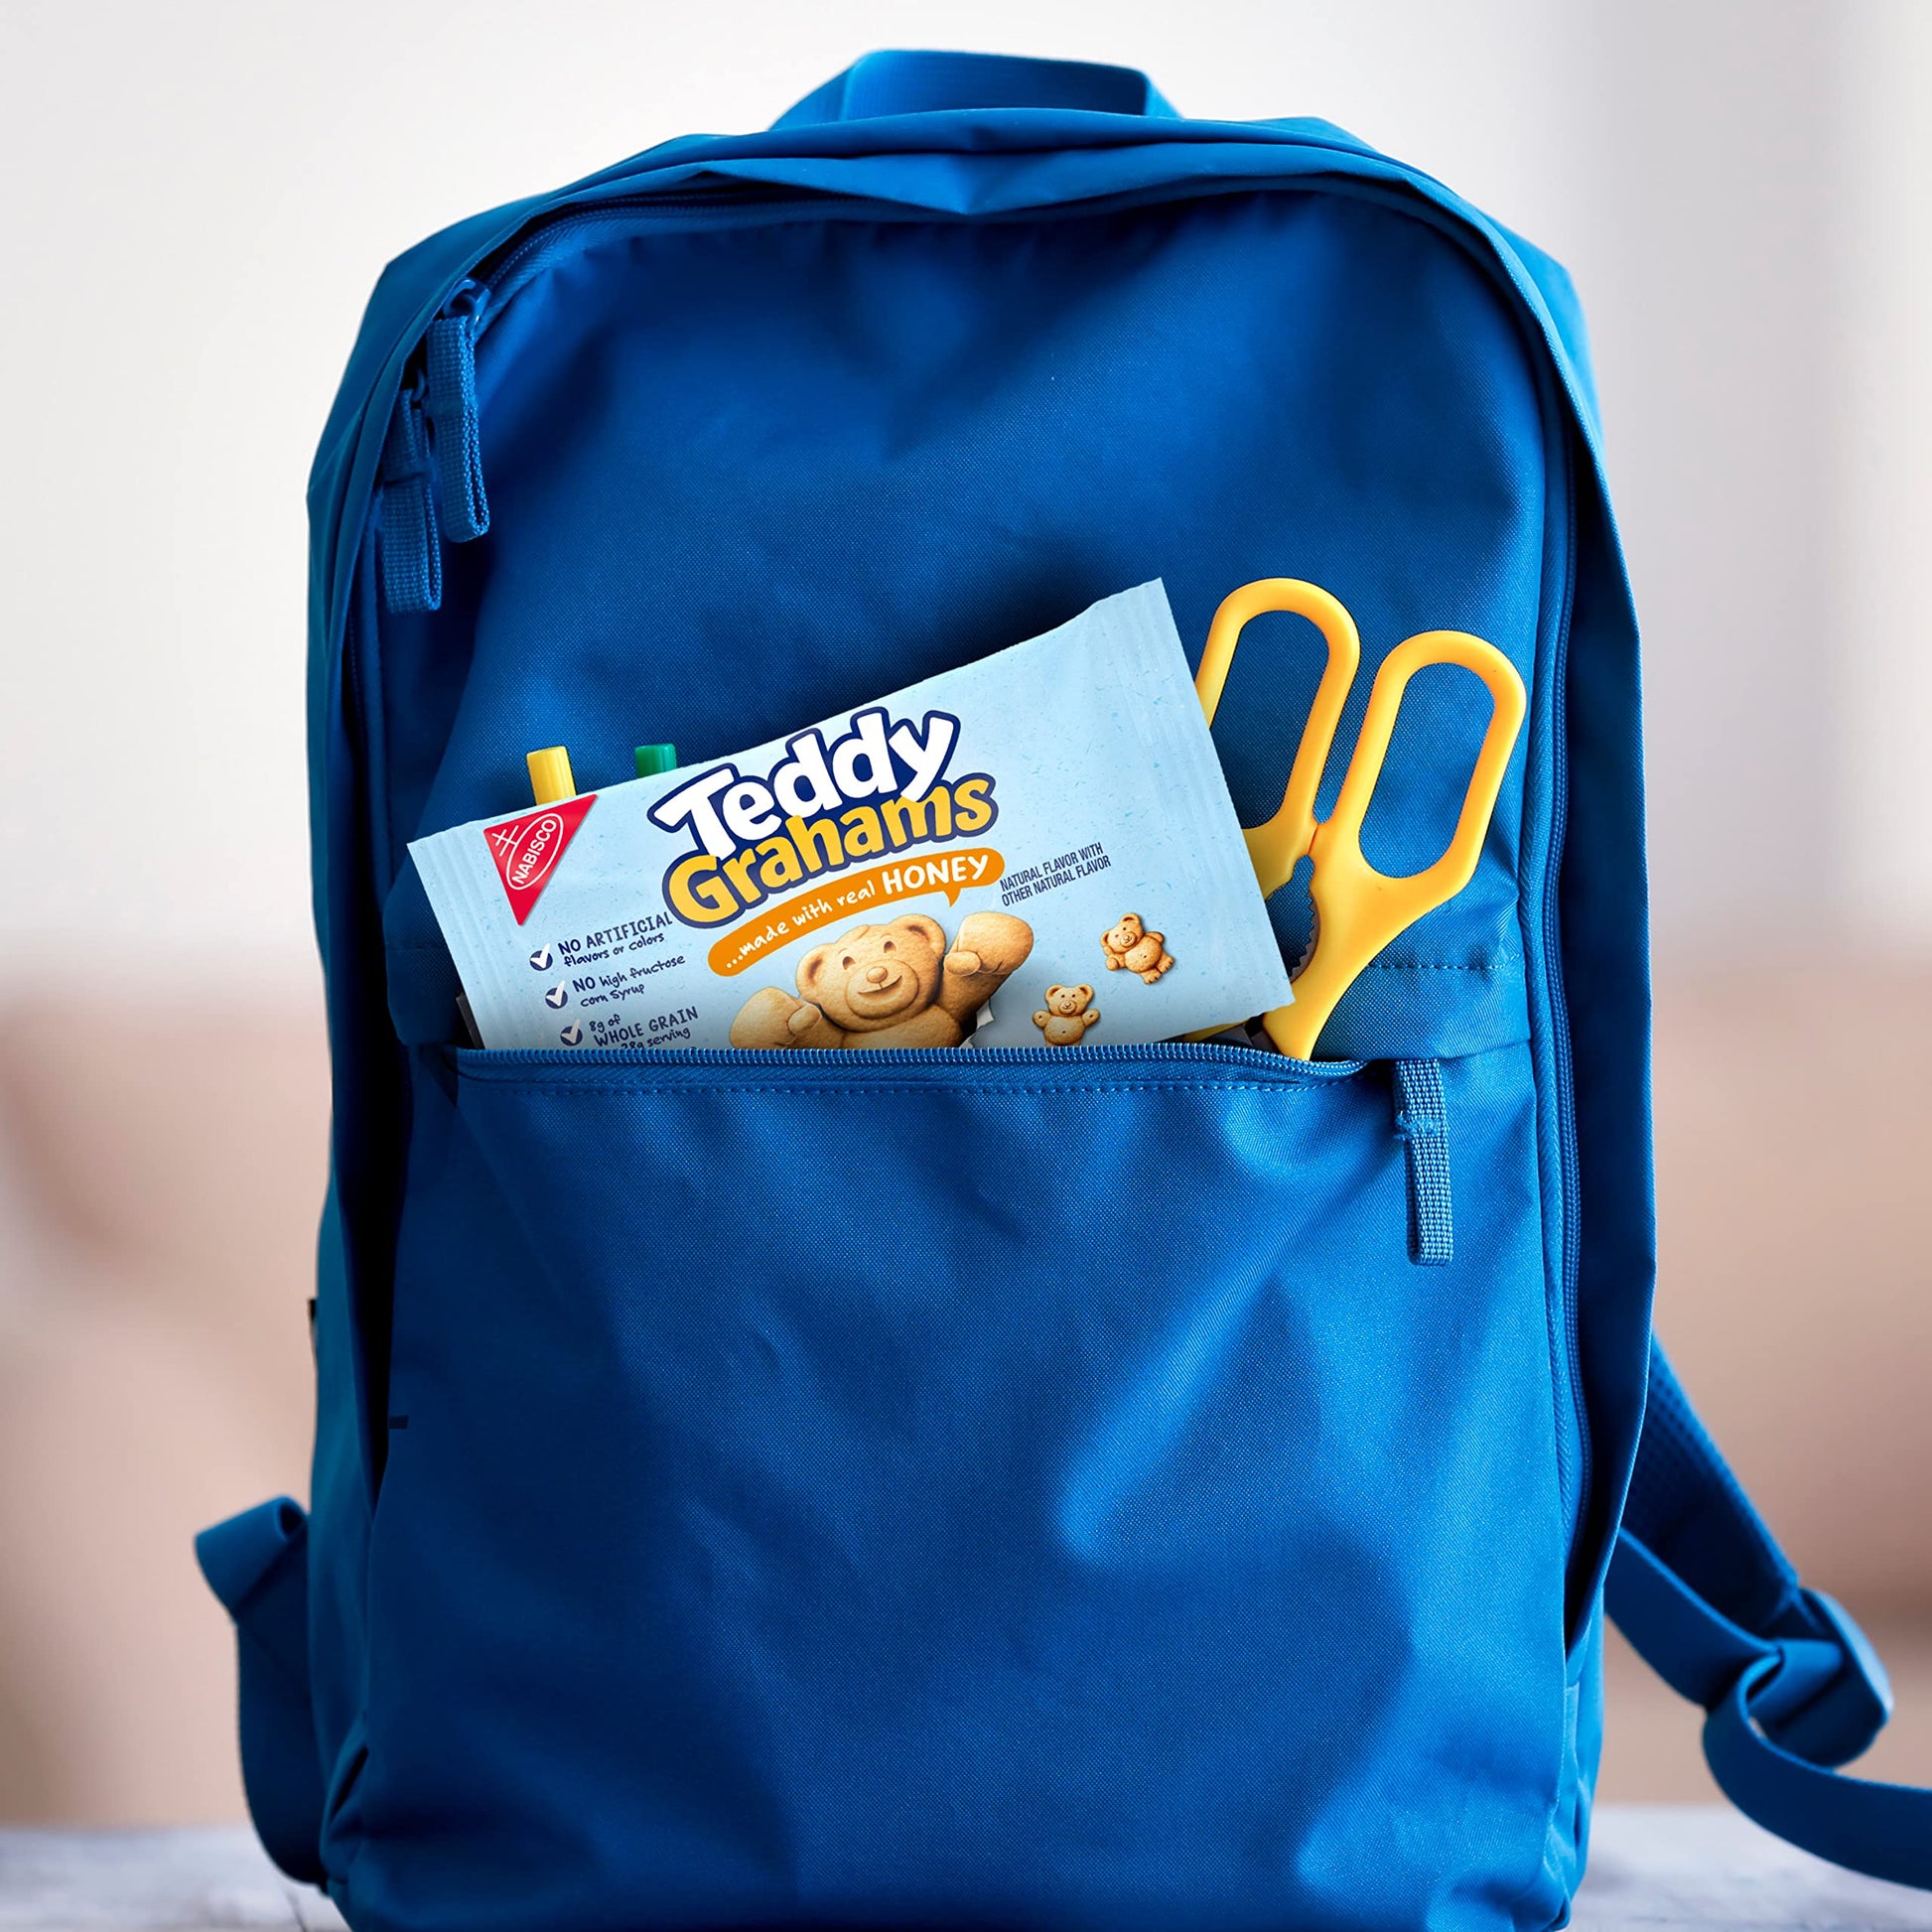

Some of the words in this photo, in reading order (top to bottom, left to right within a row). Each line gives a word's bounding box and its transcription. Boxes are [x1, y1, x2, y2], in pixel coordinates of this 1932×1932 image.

[650, 709, 957, 861] Teddy
[511, 819, 557, 884] NABISCO
[665, 776, 996, 925] Grahams
[1000, 866, 1042, 892] NATURAL
[1042, 852, 1079, 875] FLAVOR
[1078, 842, 1104, 861] WITH
[792, 899, 833, 926] with
[837, 880, 876, 906] real
[882, 854, 989, 895] HONEY
[1002, 885, 1033, 906] OTHER
[1033, 869, 1076, 895] NATURAL
[1075, 855, 1111, 879] FLAVOR
[557, 938, 582, 955] NO
[586, 911, 673, 949] ARTIFICIAL
[564, 949, 610, 967] flavors
[613, 945, 624, 955] or
[628, 932, 665, 951] colors
[572, 976, 596, 993] NO
[599, 972, 627, 989] high
[629, 955, 686, 979] fructose
[580, 995, 609, 1008] corn
[589, 1020, 605, 1034] 8g
[608, 1014, 621, 1027] of
[594, 1023, 643, 1047] WHOLE
[648, 1006, 699, 1032] GRAIN
[646, 1027, 691, 1047] serving
